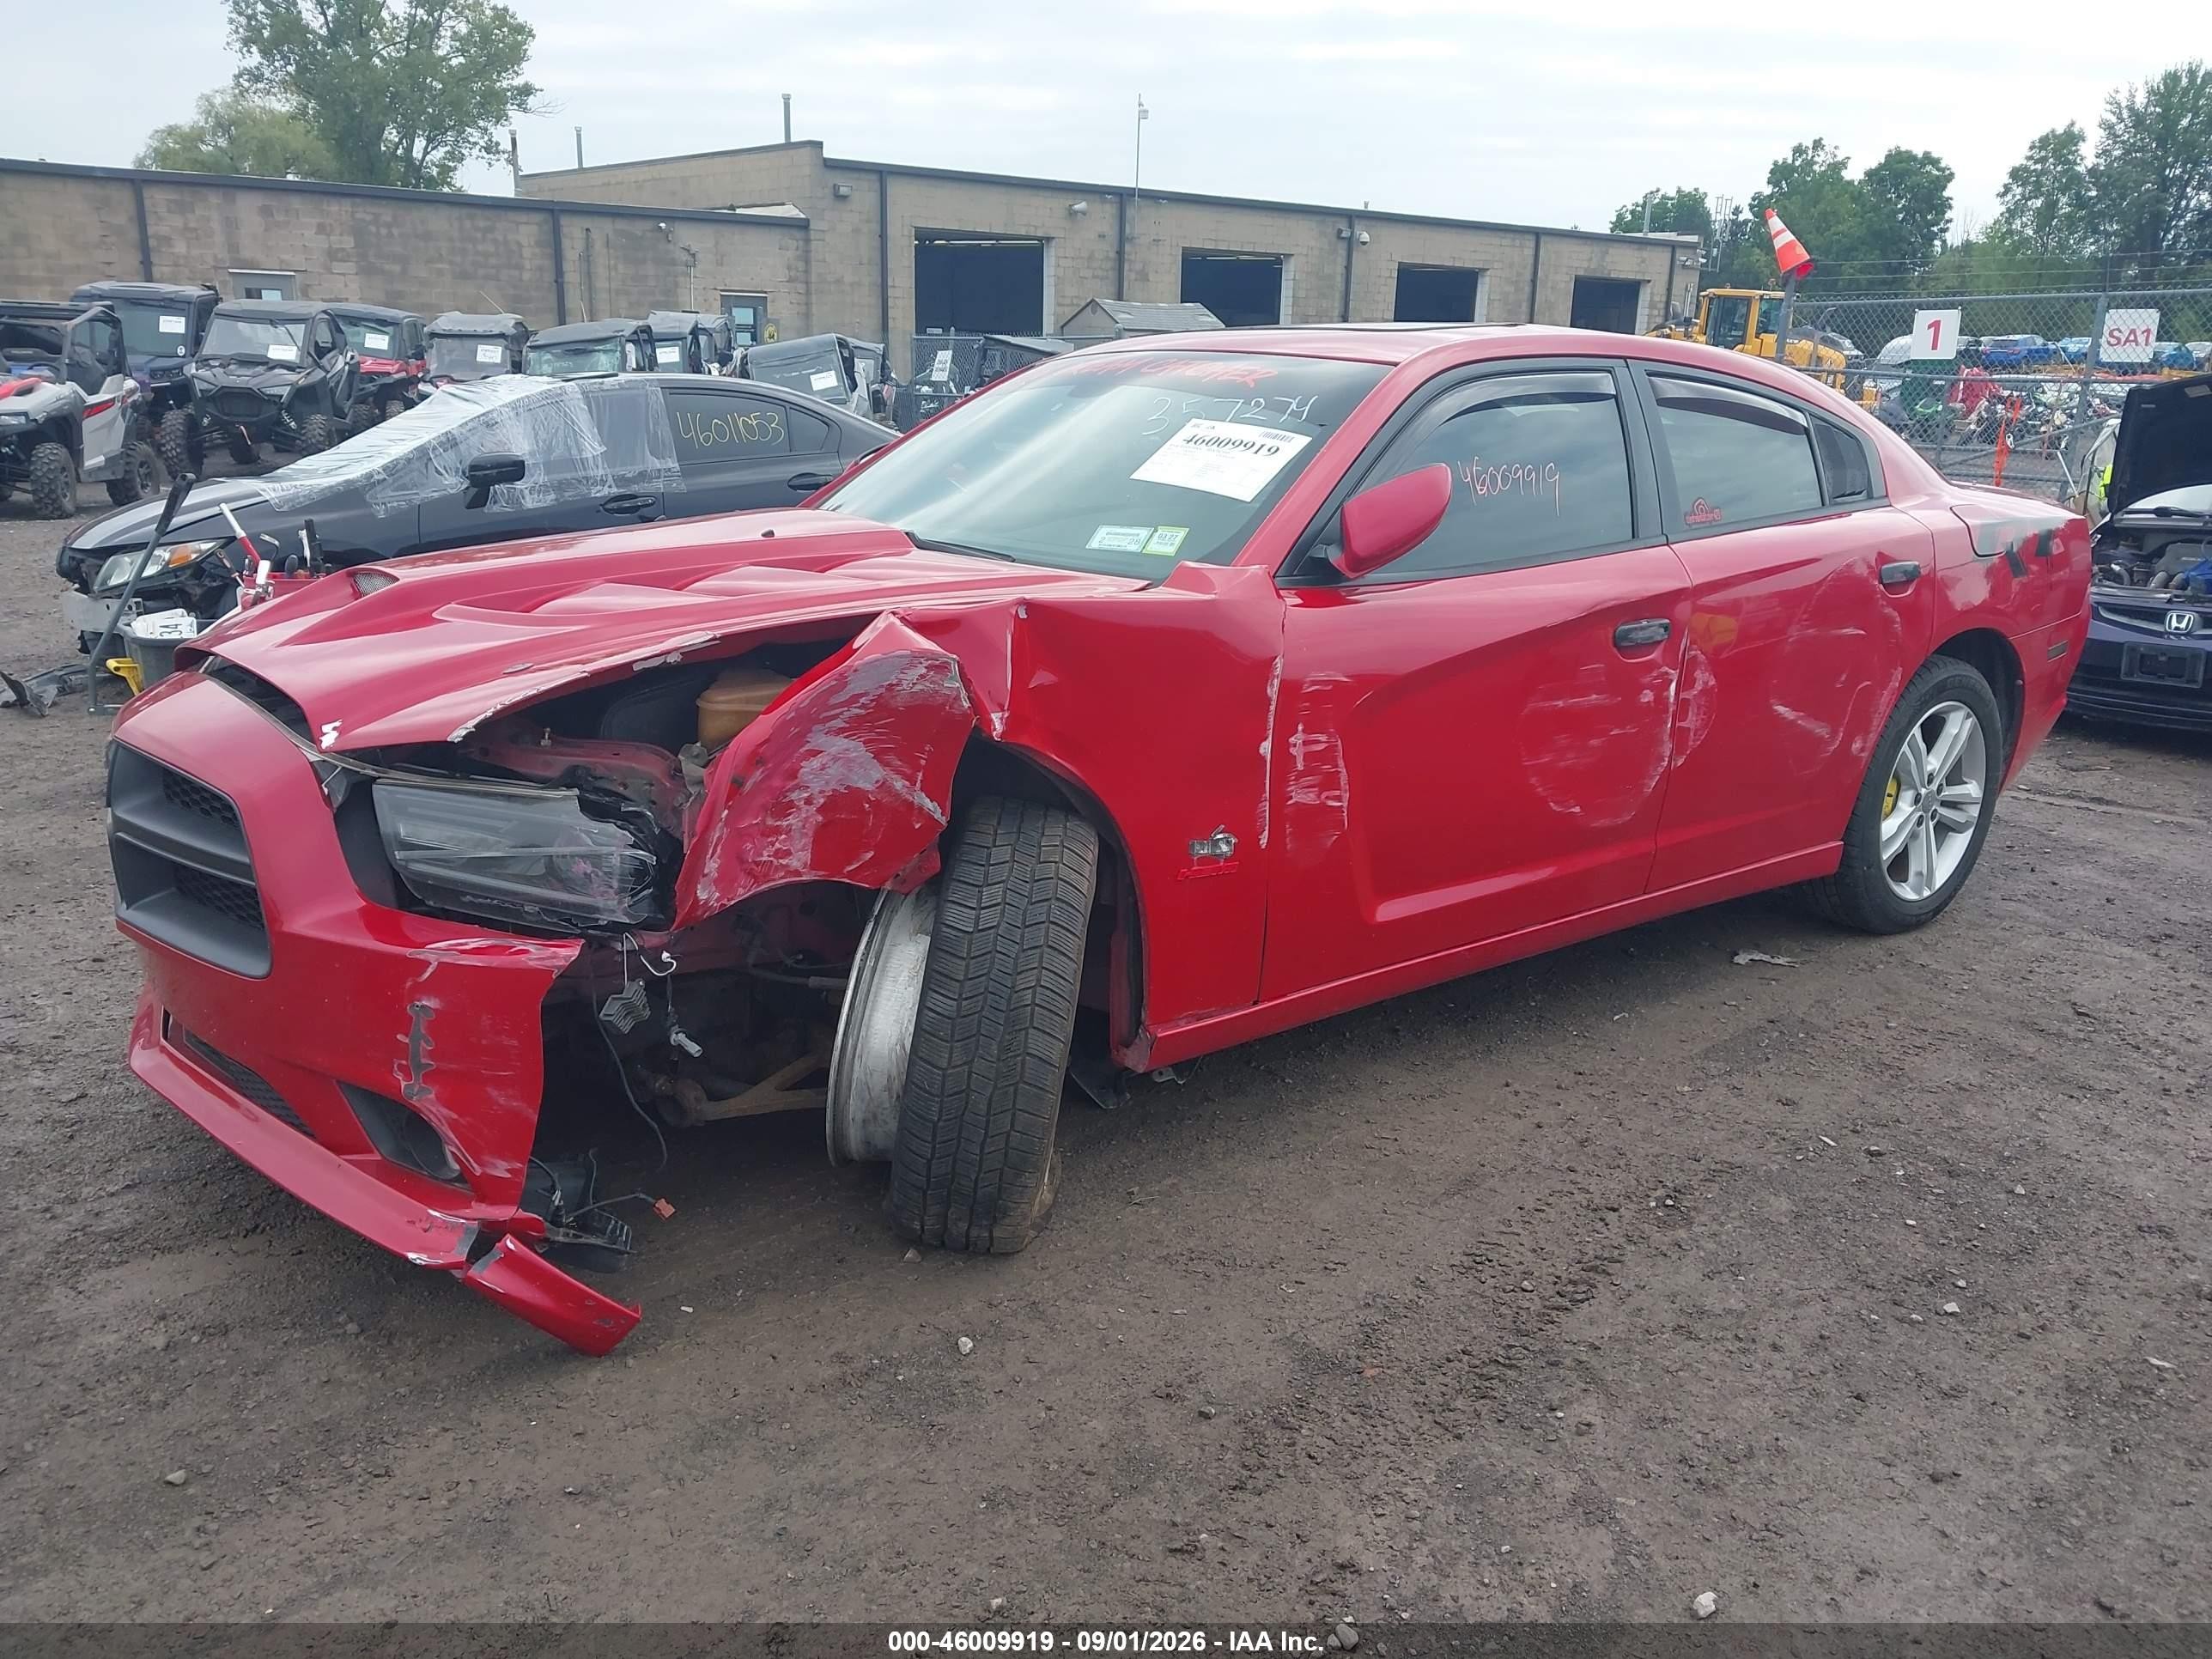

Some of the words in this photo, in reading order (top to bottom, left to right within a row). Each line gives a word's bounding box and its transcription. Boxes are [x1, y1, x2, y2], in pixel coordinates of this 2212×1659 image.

[1926, 319, 1942, 350] 1
[2106, 327, 2152, 348] SA1
[676, 411, 785, 449] 46011053
[1182, 433, 1280, 457] 46009919
[1457, 455, 1560, 517] 46009919
